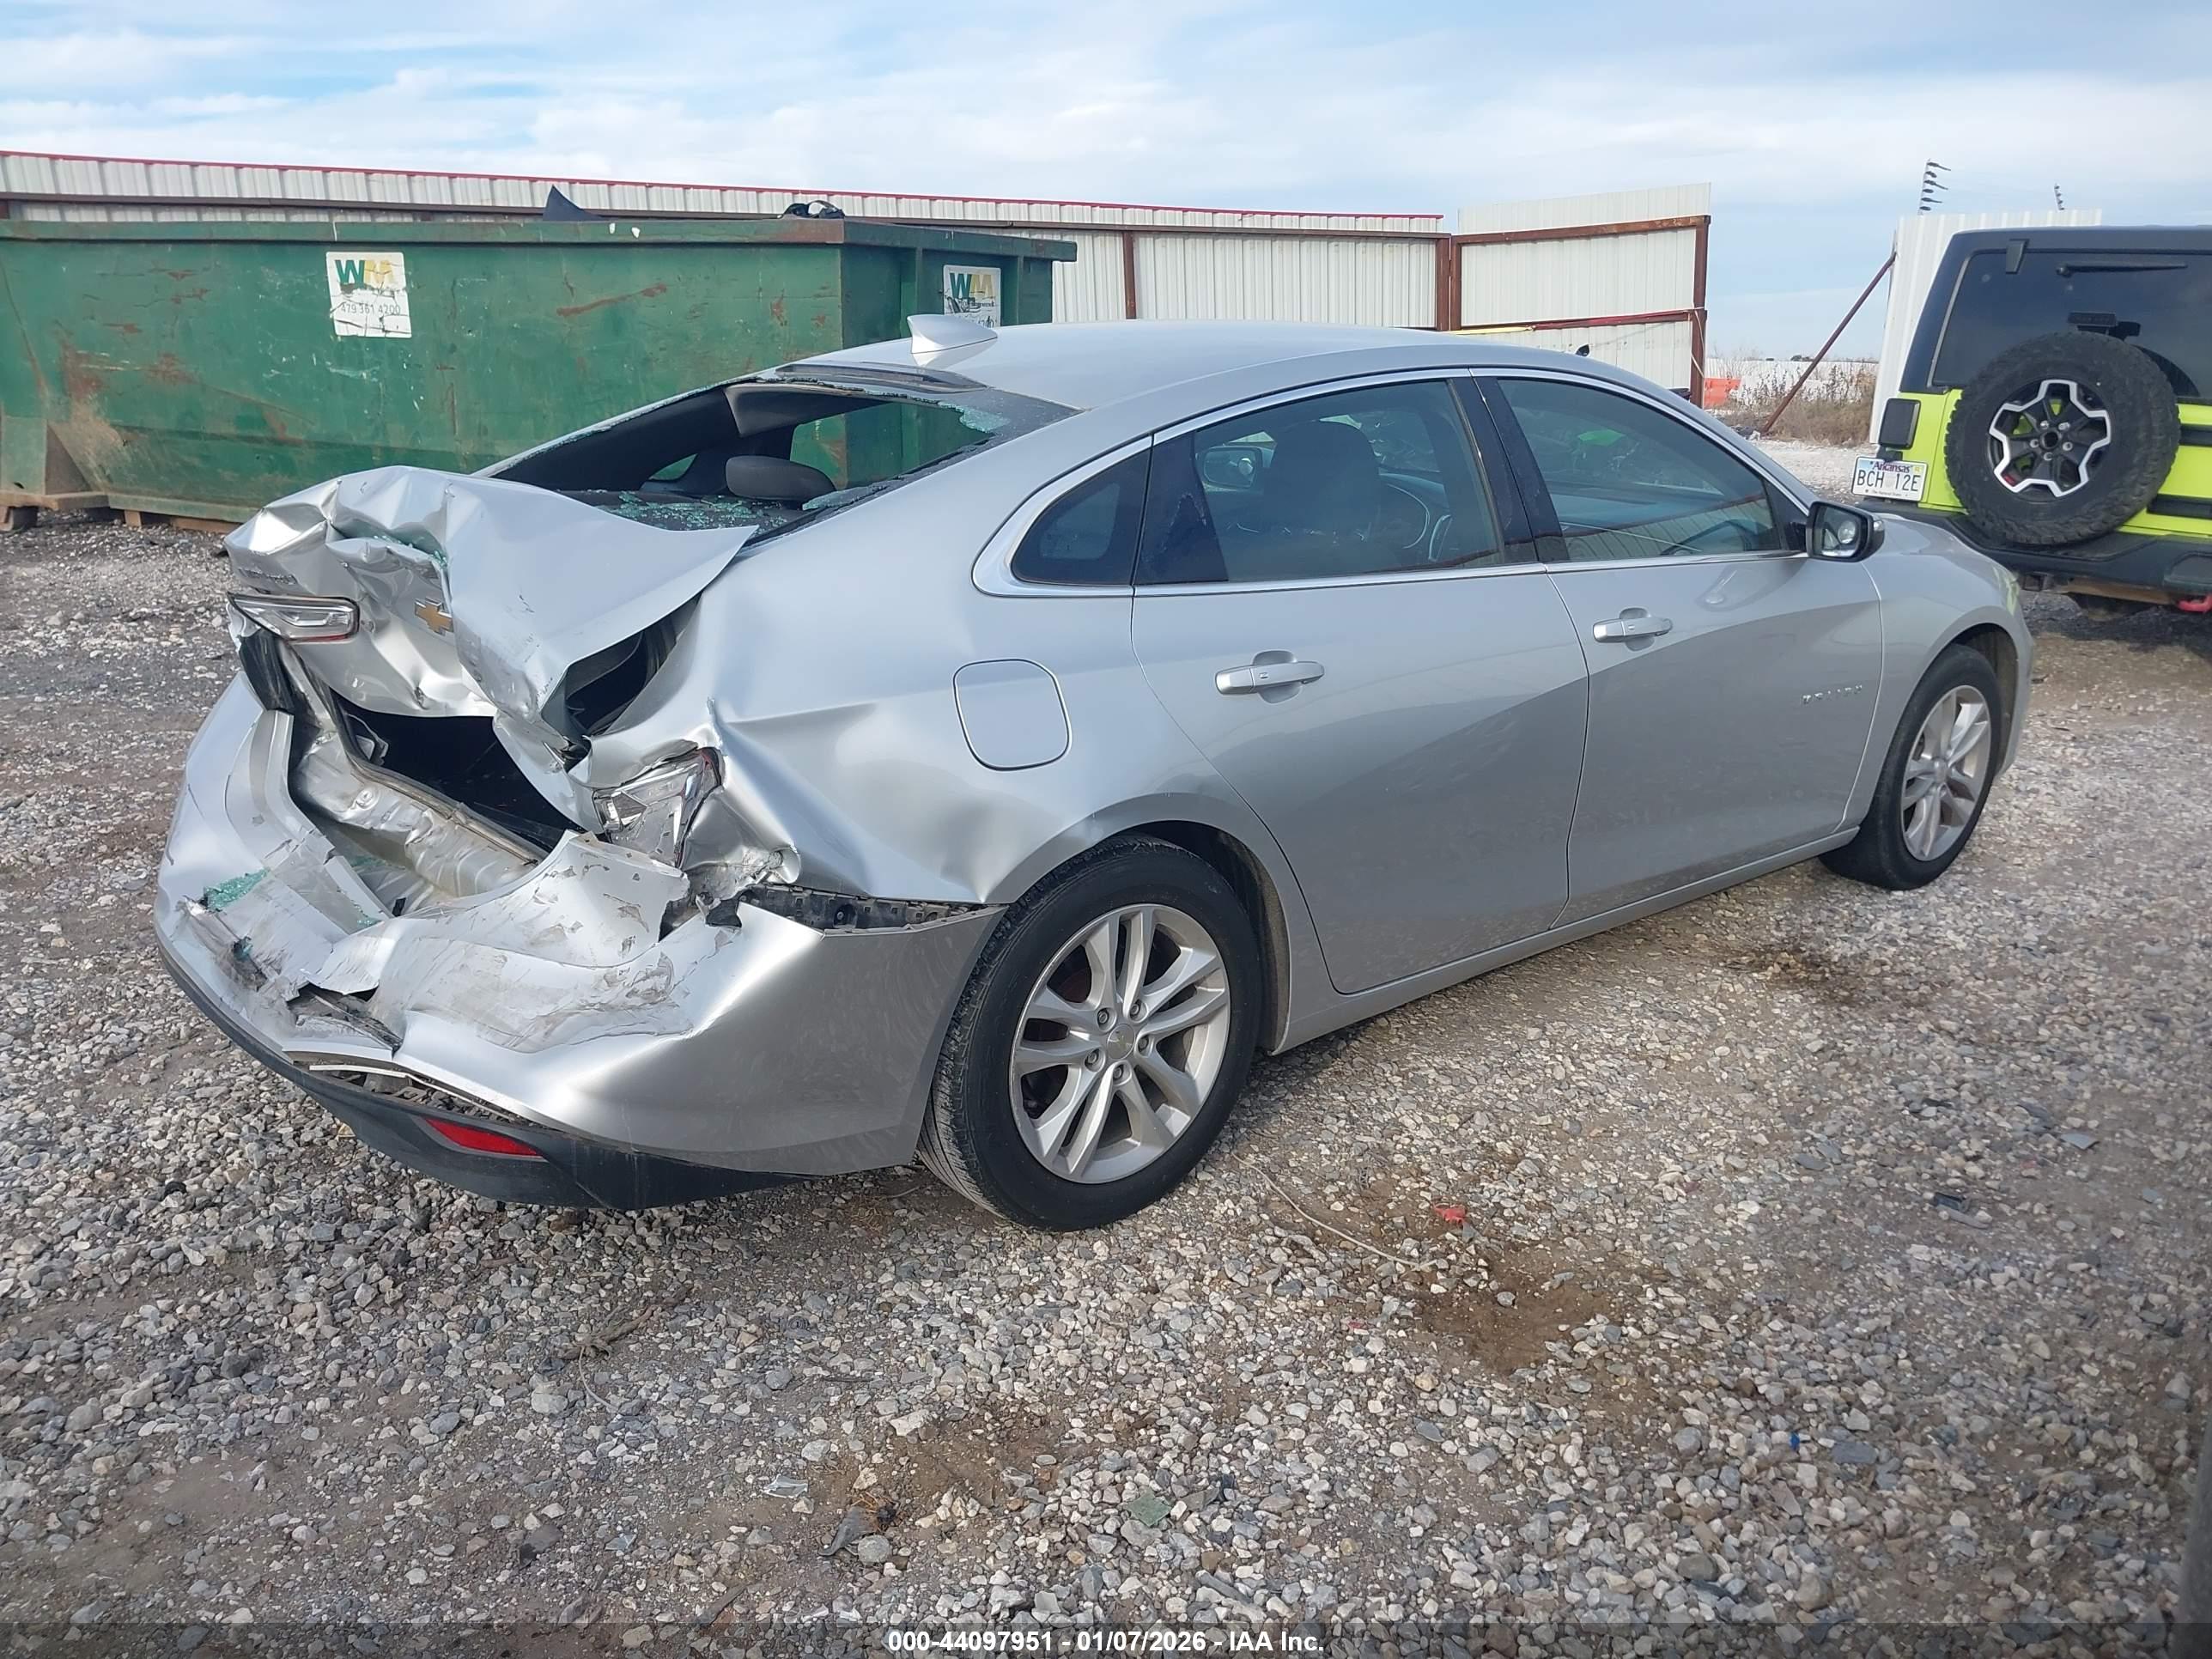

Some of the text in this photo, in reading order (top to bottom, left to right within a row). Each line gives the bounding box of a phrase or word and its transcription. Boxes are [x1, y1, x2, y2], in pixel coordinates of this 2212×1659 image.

[1873, 461, 1911, 473] Arkansas
[1856, 470, 1921, 492] BCH 12E
